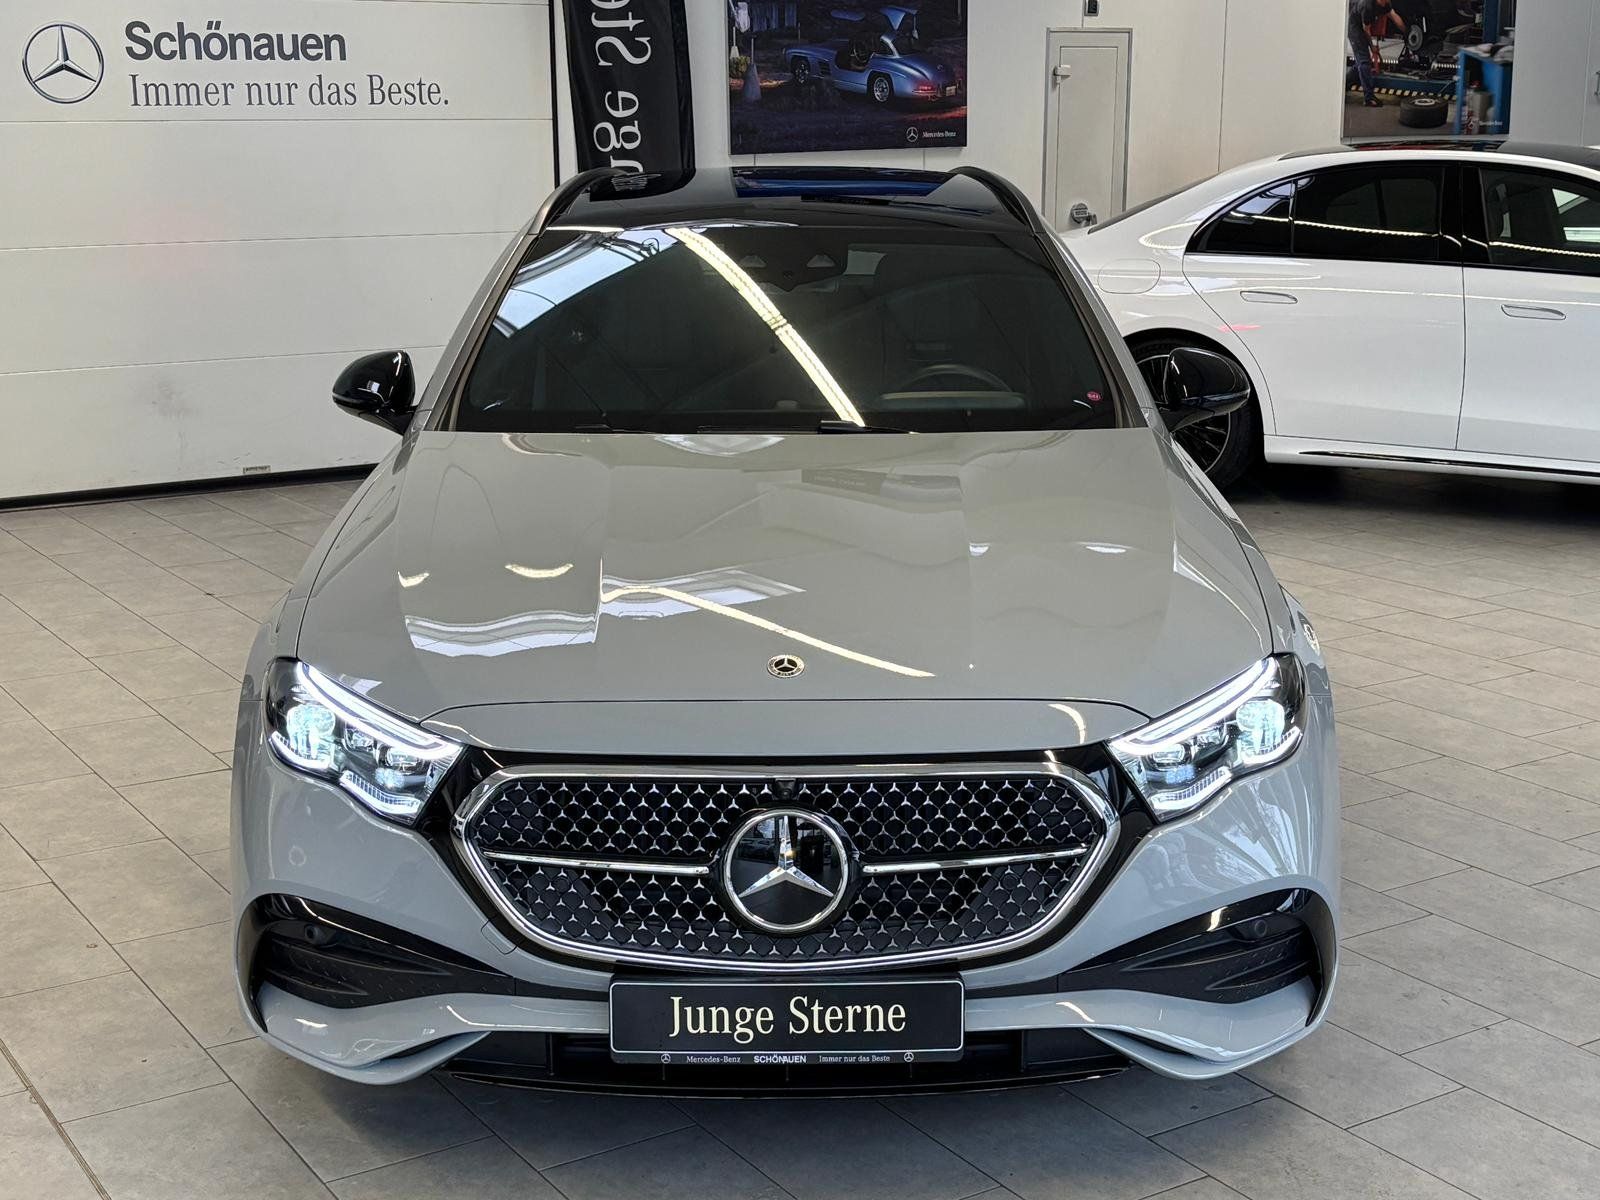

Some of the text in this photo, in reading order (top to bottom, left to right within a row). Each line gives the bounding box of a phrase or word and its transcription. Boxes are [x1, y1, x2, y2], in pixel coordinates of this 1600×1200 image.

[125, 20, 347, 62] Schönauen
[128, 73, 449, 107] Immer nur das Beste.
[669, 995, 906, 1044] Junge Sterne
[686, 1055, 741, 1063] Mercedes-Benz
[753, 1053, 807, 1064] SCHÖNAUEN
[819, 1055, 842, 1063] Immer
[857, 1055, 870, 1063] das
